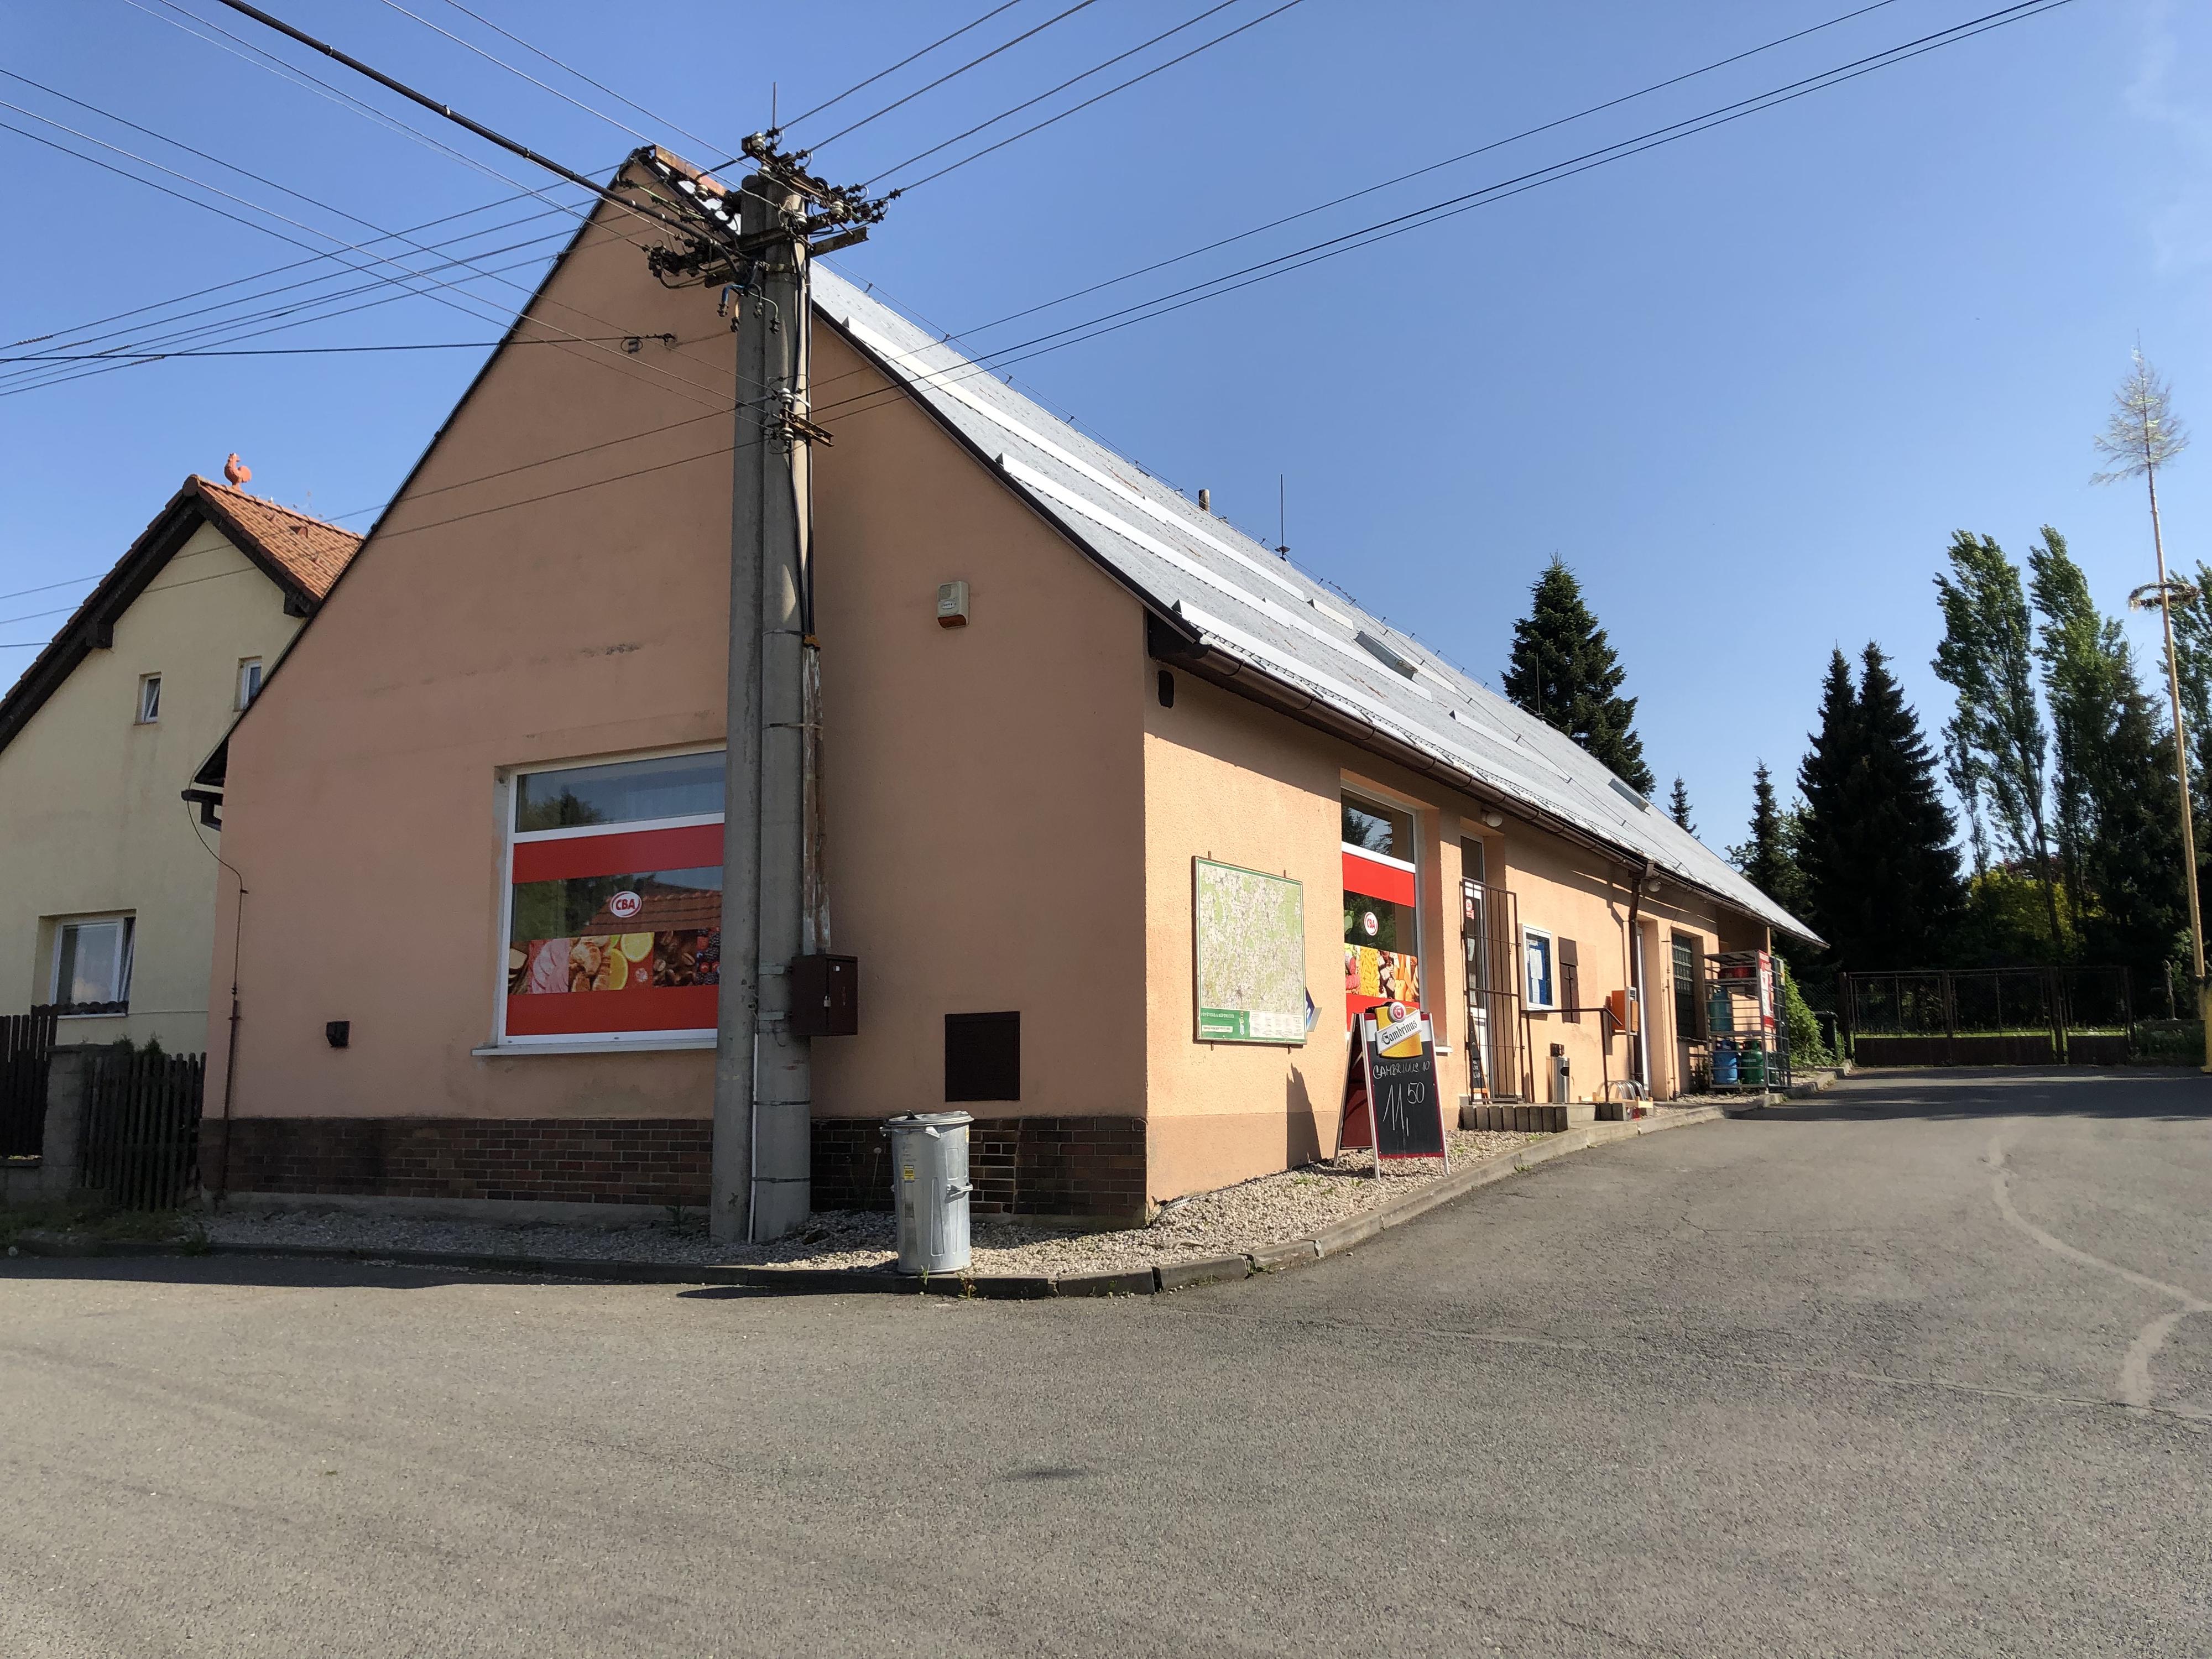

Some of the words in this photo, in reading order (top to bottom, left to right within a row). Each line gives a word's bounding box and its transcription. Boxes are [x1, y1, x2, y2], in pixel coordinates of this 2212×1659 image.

[616, 899, 635, 910] CBA
[1367, 918, 1375, 929] CBA
[1382, 1020, 1417, 1045] Gambrinus
[1423, 1061, 1430, 1072] 10
